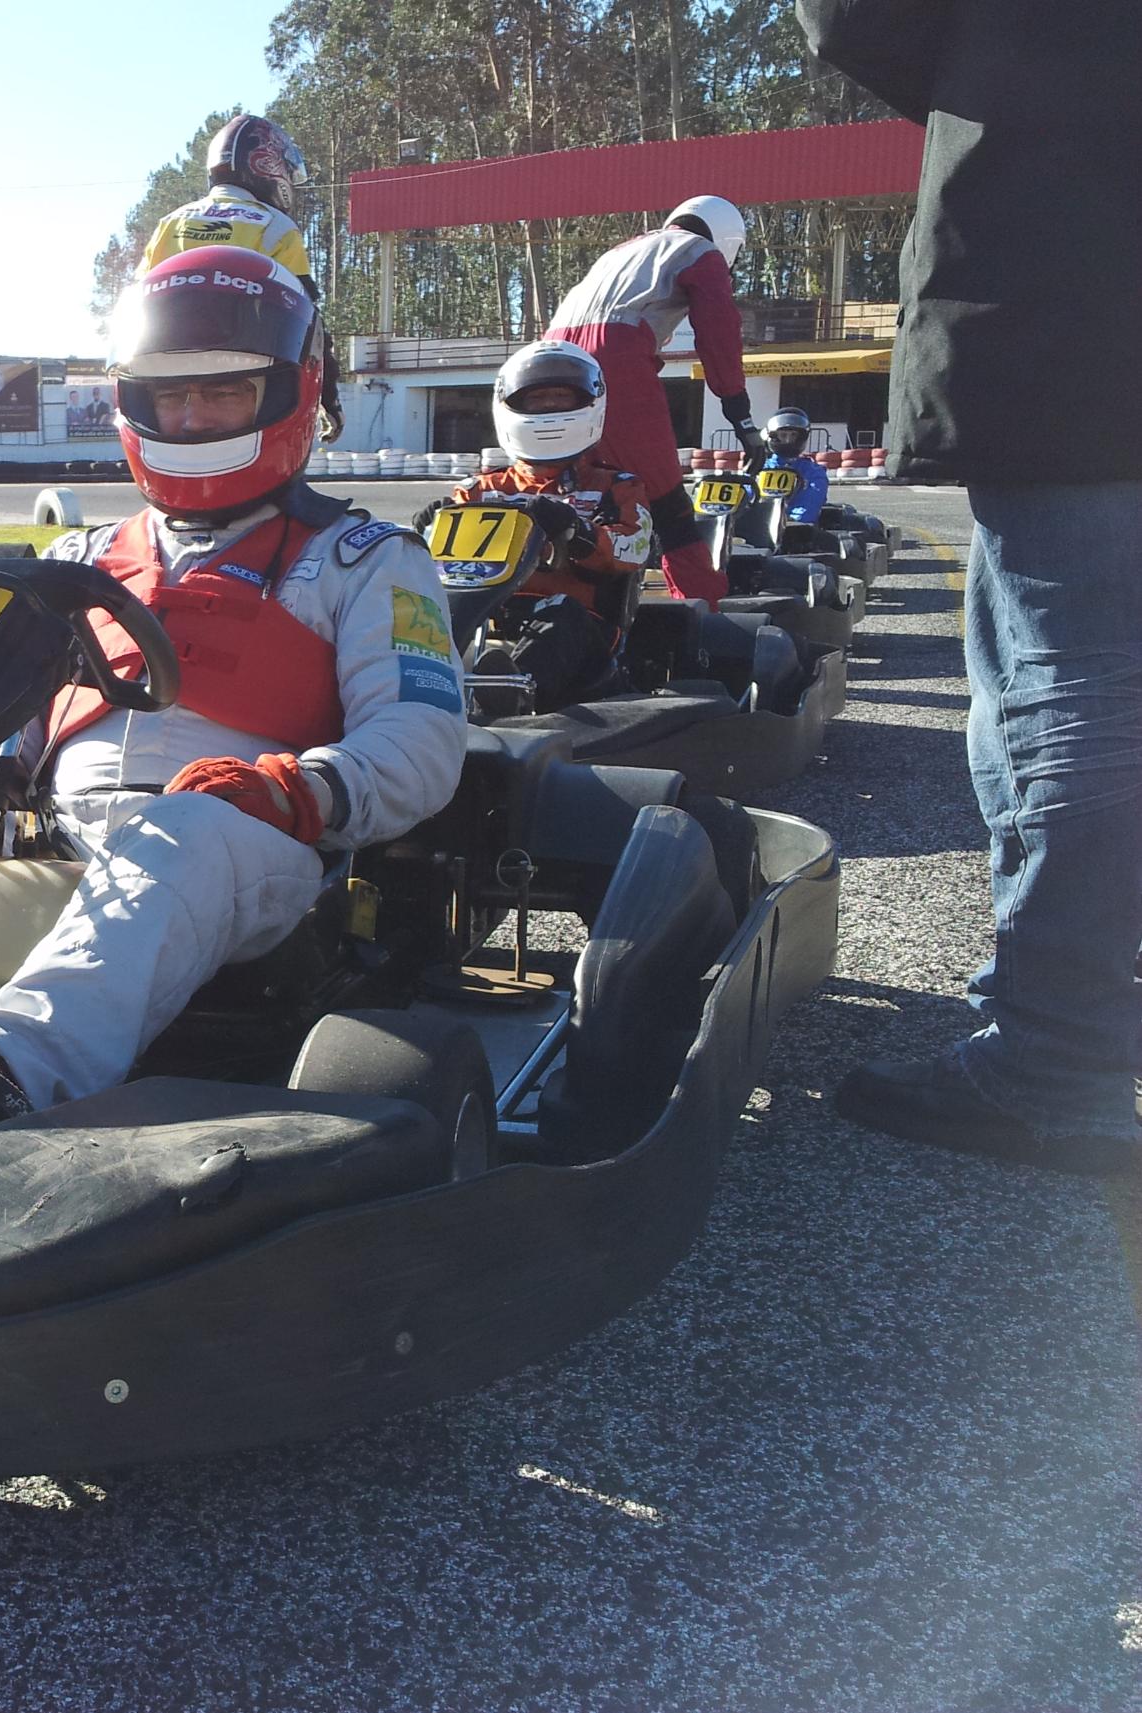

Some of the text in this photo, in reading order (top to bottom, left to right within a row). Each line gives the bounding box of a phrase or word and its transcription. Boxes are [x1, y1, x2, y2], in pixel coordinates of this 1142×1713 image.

[143, 270, 264, 296] lube bcp
[766, 472, 789, 489] 10
[705, 483, 733, 502] 16
[436, 512, 506, 558] 17
[449, 561, 476, 573] 24
